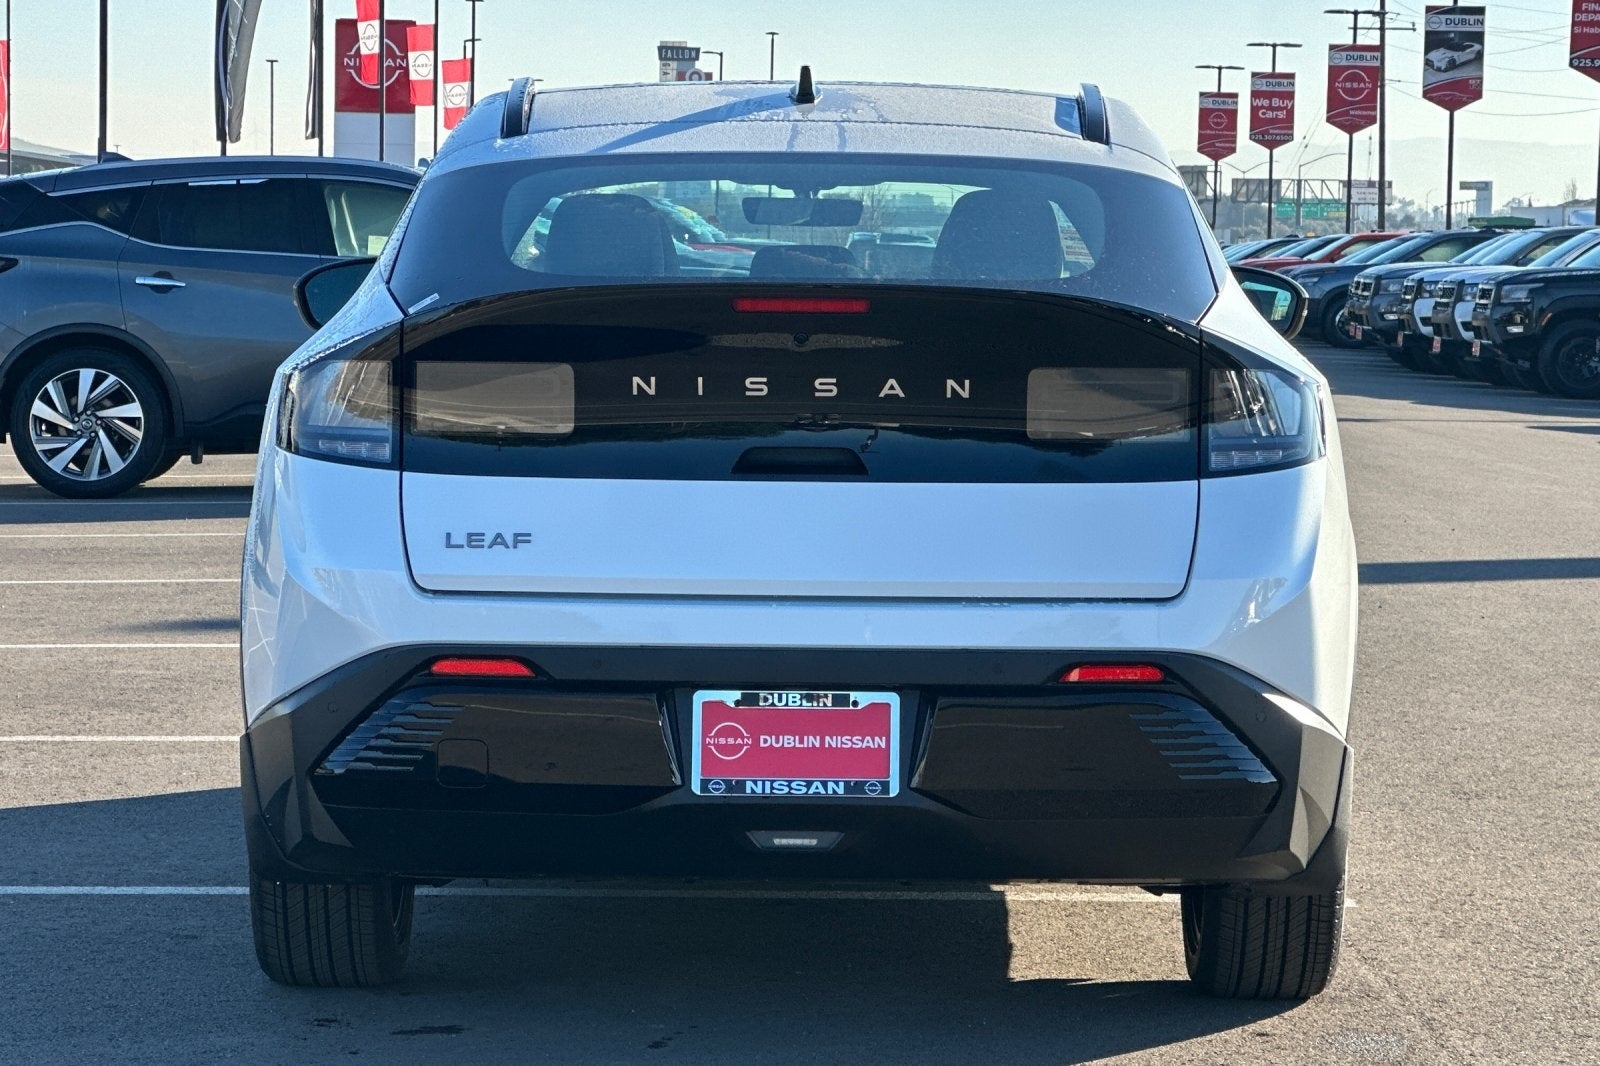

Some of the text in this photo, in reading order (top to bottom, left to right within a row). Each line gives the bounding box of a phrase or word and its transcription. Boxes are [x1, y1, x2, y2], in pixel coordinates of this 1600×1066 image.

[1582, 2, 1600, 11] FIN
[1445, 18, 1484, 26] DUBLIN
[661, 49, 696, 59] FALLON
[1345, 54, 1379, 62] DUBLIN
[343, 57, 407, 67] NIAN
[1252, 98, 1293, 110] We Buy
[1259, 110, 1286, 119] Cars!
[632, 376, 970, 399] NISSAN
[445, 532, 532, 549] LEAF
[759, 693, 832, 707] DUBLIN
[706, 737, 752, 745] NISSAN
[759, 735, 886, 749] DUBLIN NISSAN
[745, 780, 845, 795] NISSAN
